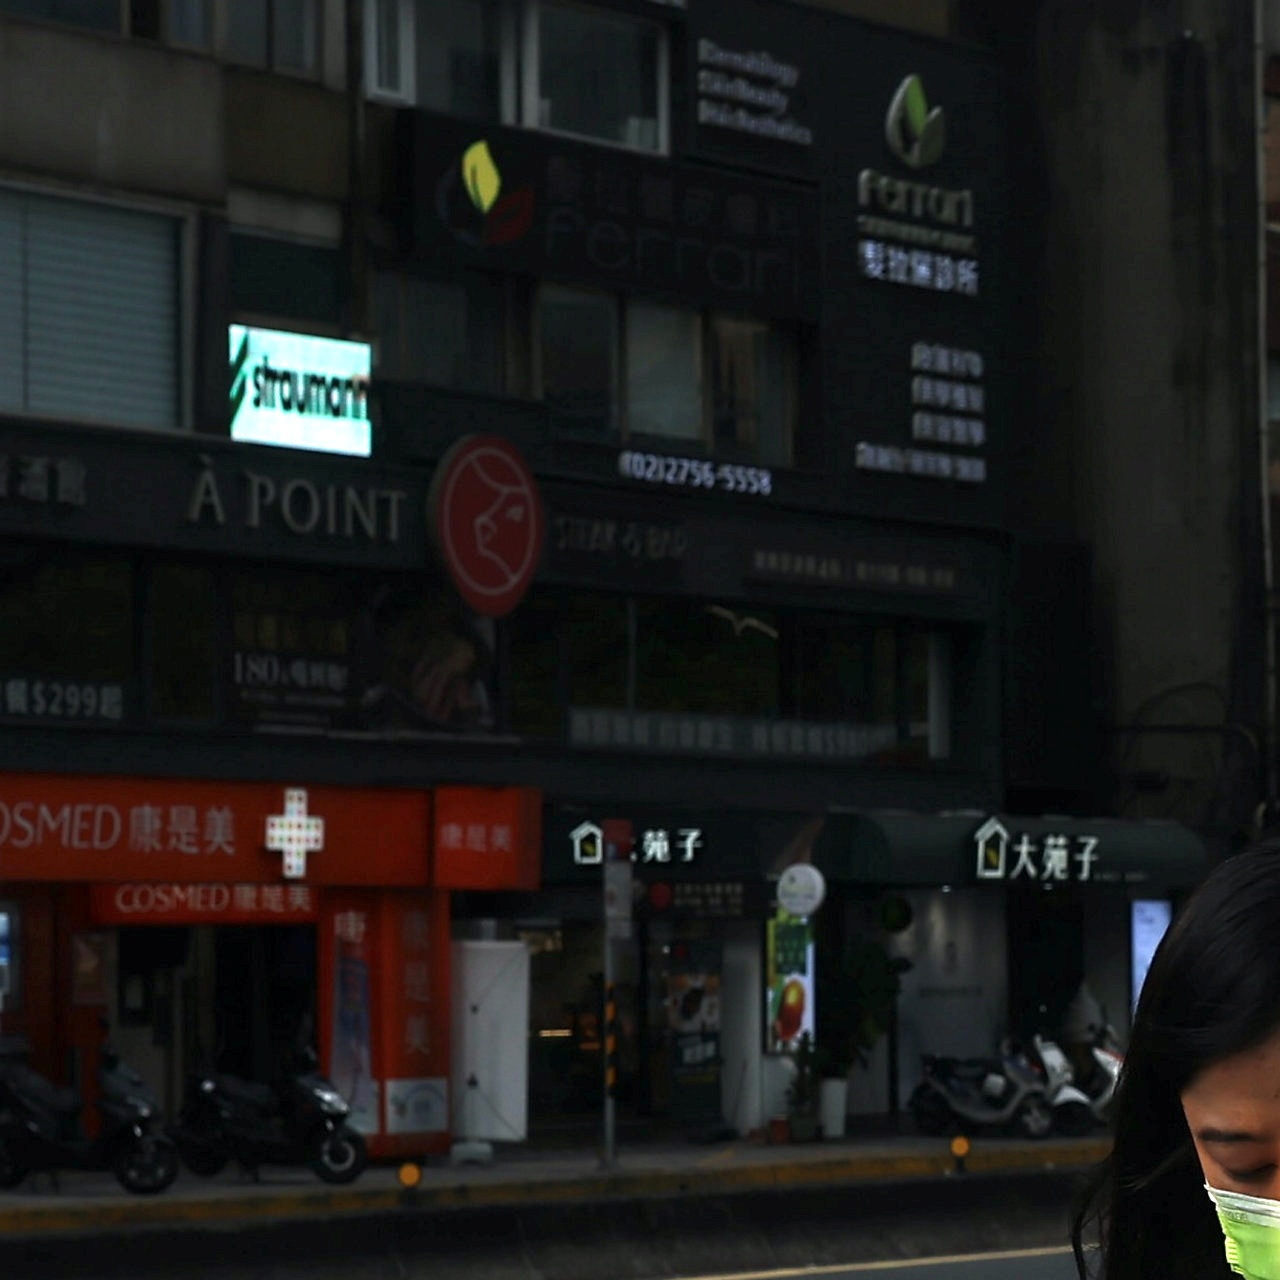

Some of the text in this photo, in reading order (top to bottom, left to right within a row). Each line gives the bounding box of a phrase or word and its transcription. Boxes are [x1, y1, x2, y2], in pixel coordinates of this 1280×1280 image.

[246, 469, 408, 542] POINT
[129, 803, 236, 855] 康是美
[440, 822, 513, 853] 康是美
[628, 827, 705, 866] 苑子
[1010, 835, 1100, 882] 大苑子
[115, 882, 312, 913] COSMED 康是美
